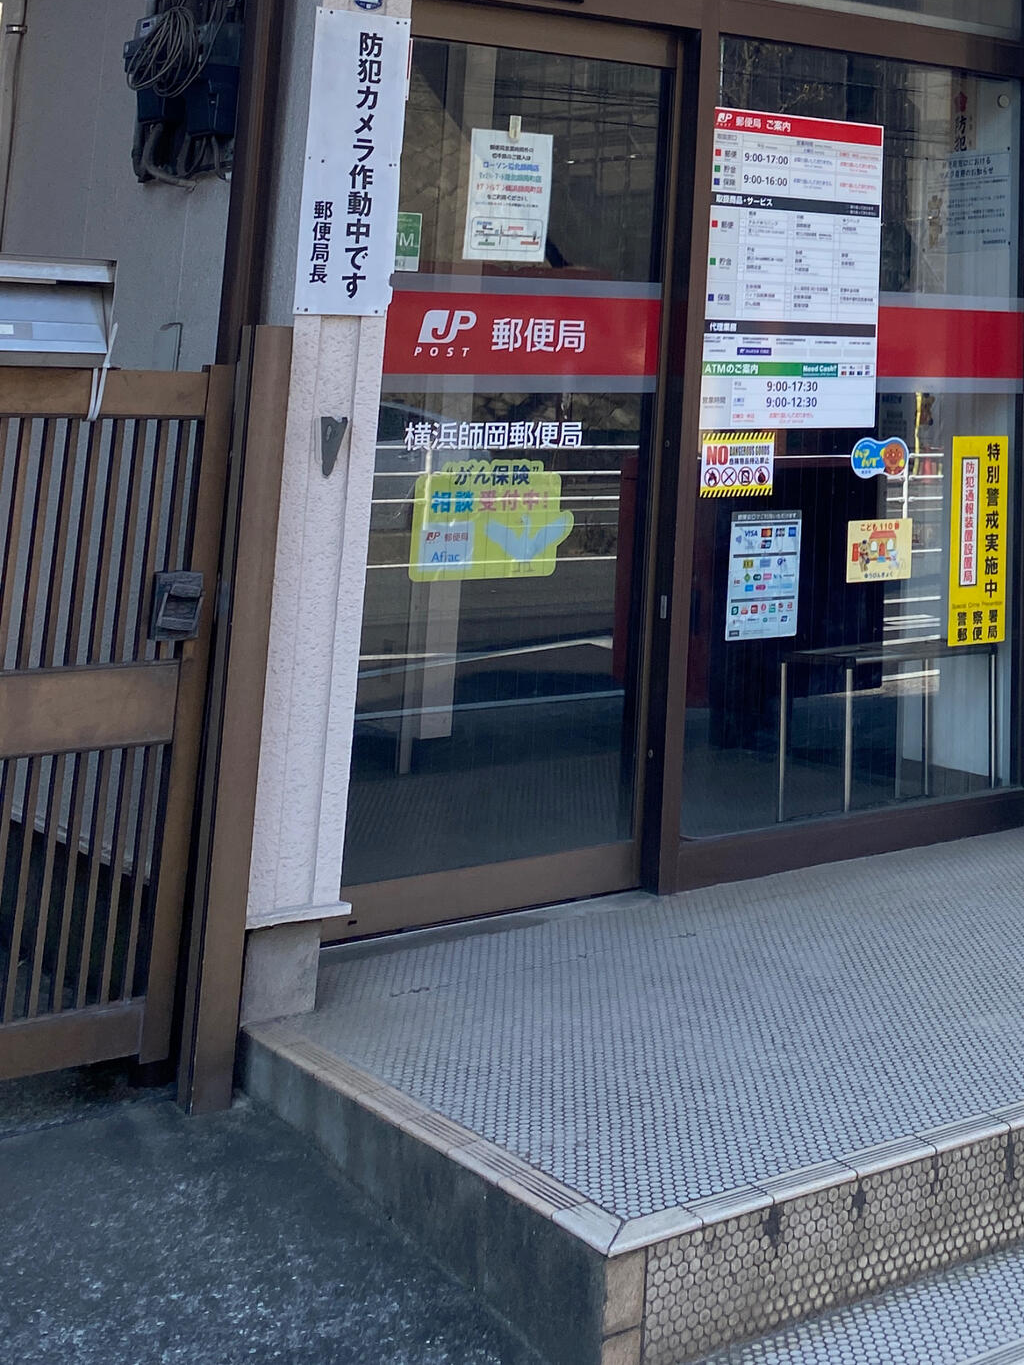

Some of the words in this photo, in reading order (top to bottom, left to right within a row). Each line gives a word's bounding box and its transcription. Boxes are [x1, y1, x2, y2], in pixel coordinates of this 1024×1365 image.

[735, 116, 762, 129] 郵便局
[766, 119, 791, 133] ご案内
[342, 32, 384, 299] 防犯カメラ作動中です
[744, 152, 789, 166] 9:00-17:00
[743, 174, 788, 187] 9:00-16:00
[309, 200, 334, 284] 郵便局長
[417, 309, 477, 344] JP
[491, 317, 586, 354] 郵便局
[413, 347, 471, 358] POST
[766, 380, 818, 392] 9:00-17:30
[766, 396, 817, 408] 9:00-12:30
[404, 421, 583, 452] 横浜師岡郵便局
[706, 445, 729, 466] NO
[984, 442, 1001, 599] 特別警戒実施中
[431, 551, 461, 563] Aflac
[957, 625, 998, 642] 郵便局
